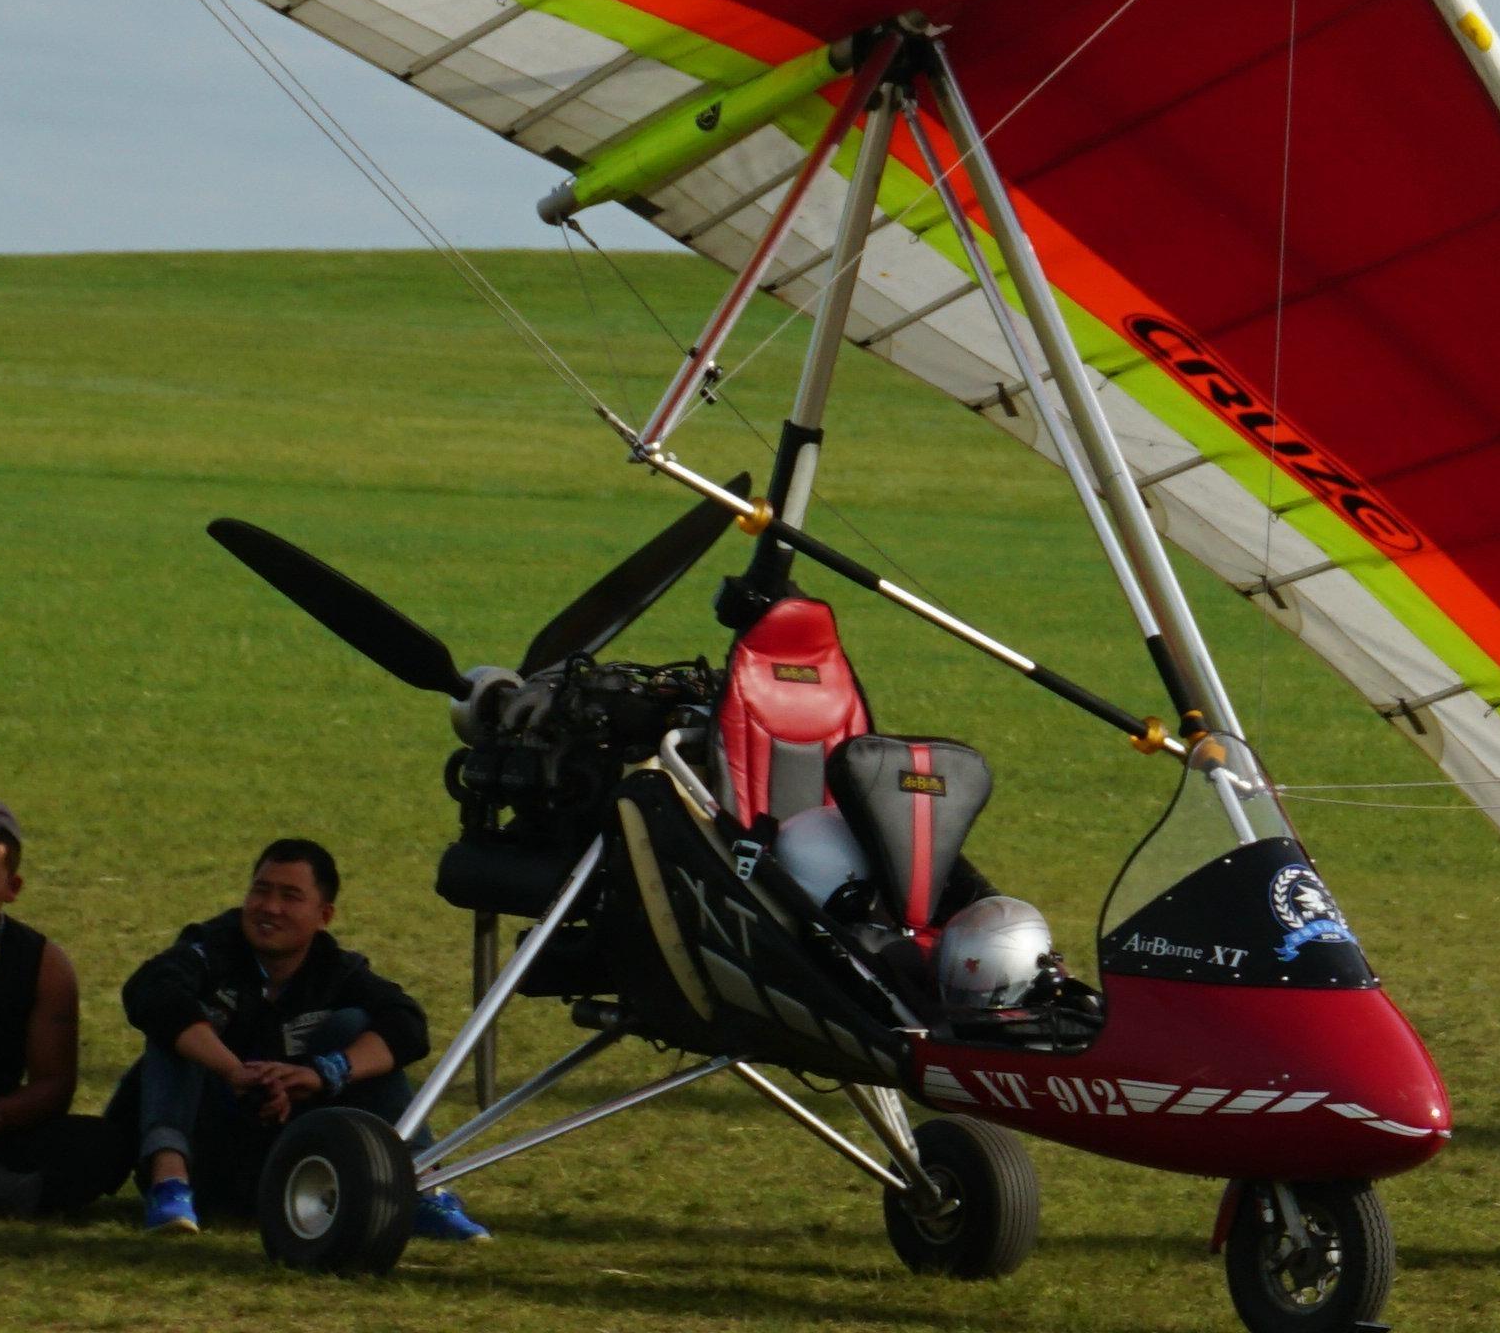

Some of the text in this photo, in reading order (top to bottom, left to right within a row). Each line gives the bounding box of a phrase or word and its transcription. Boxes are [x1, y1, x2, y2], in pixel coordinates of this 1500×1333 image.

[1121, 931, 1250, 968] AirBorne XT
[970, 1069, 1128, 1117] XT-912
